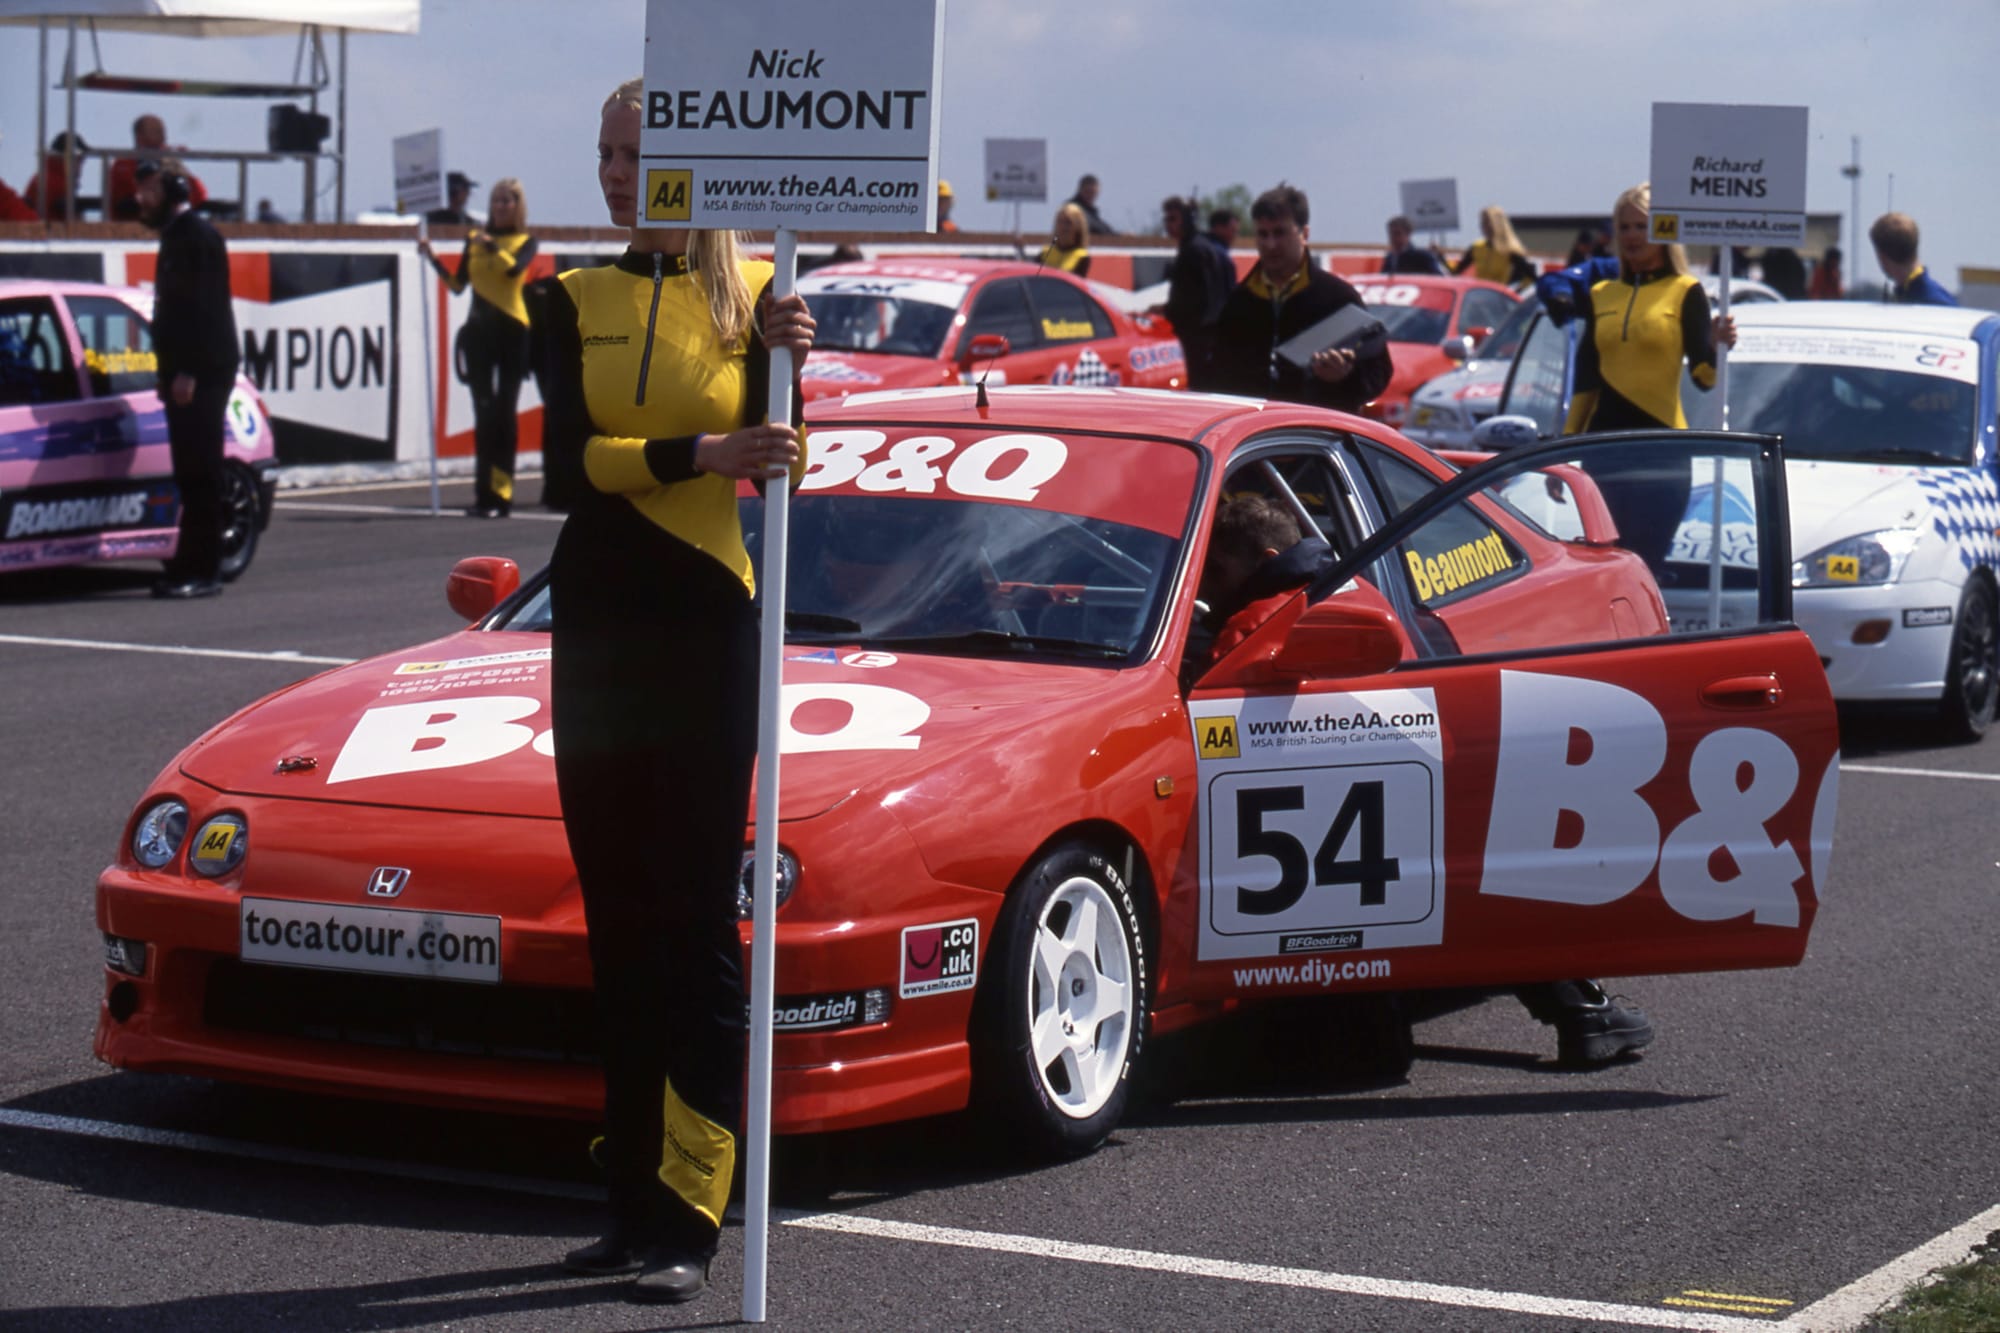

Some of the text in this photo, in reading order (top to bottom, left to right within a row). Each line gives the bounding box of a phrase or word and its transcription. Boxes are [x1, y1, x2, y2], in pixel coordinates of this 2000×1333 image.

[747, 49, 825, 79] Nick
[647, 90, 926, 130] BEAUMONT
[1692, 156, 1764, 174] Richard
[651, 181, 686, 208] AA
[703, 175, 919, 199] www.theAA.com
[1690, 176, 1767, 198] MEINS
[703, 199, 919, 215] MSA British Touring Car Championship
[1683, 218, 1801, 233] www.theAA.com
[244, 325, 384, 392] MPION
[799, 429, 1069, 501] B&Q
[1405, 528, 1512, 601] Beaumont
[1831, 561, 1854, 576] AA
[440, 665, 544, 682] SPORT
[1204, 712, 1435, 749] AA www.theAA.com
[1251, 729, 1437, 748] MSA British Touring Car Championship
[1479, 668, 1841, 929] B&
[201, 832, 230, 850] AA
[1235, 780, 1400, 916] 54
[244, 909, 498, 966] tocatour.com
[943, 927, 973, 947] .co
[1286, 934, 1357, 949] BFGoodrich
[942, 950, 971, 975] .uk
[1233, 959, 1391, 987] www.diy.com
[903, 976, 974, 995] www.smile.co.uk
[773, 995, 857, 1023] oodrich
